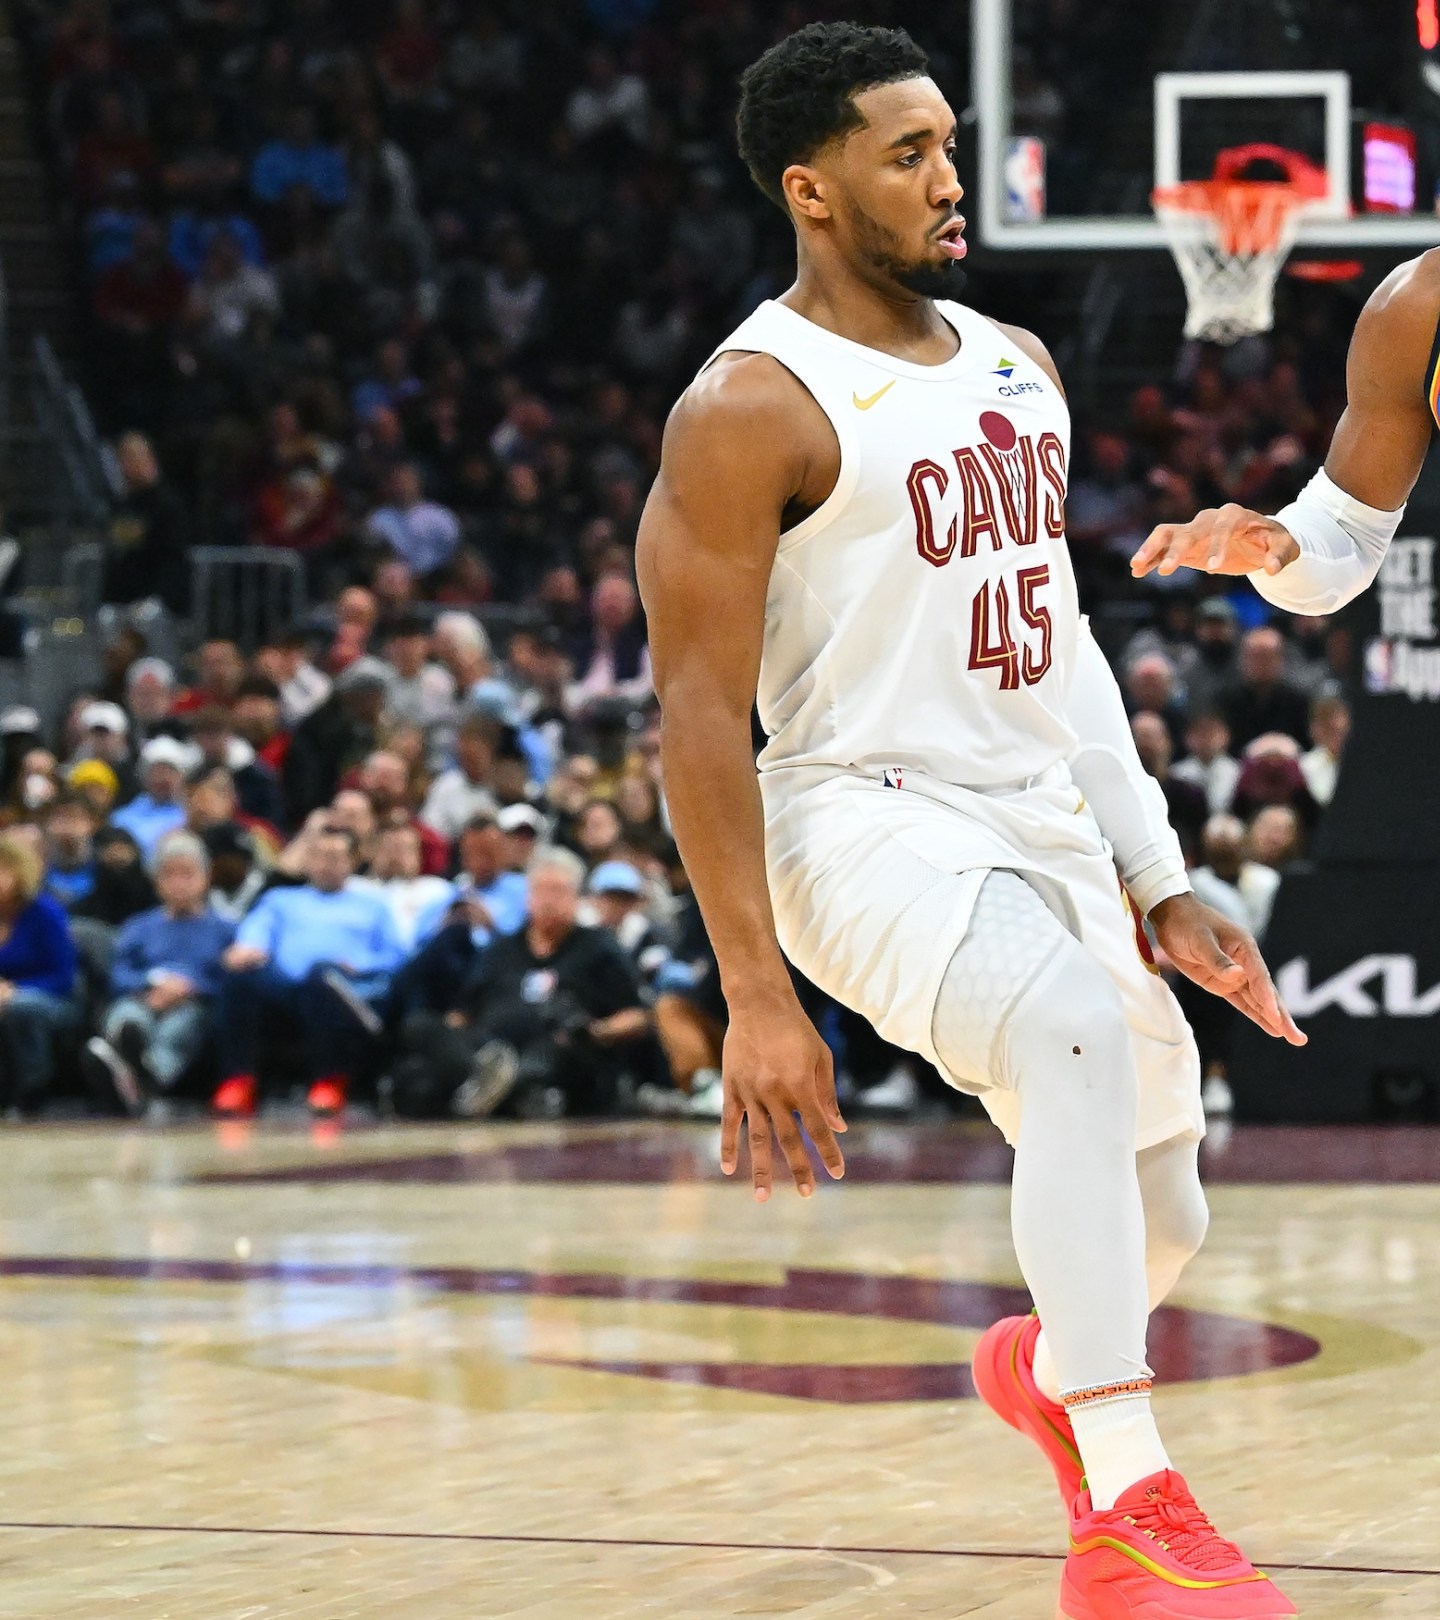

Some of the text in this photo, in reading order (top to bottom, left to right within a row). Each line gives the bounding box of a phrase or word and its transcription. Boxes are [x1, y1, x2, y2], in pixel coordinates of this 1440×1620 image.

[998, 382, 1044, 397] CLIFFS
[906, 432, 1066, 568] CAVS
[967, 563, 1053, 691] 45
